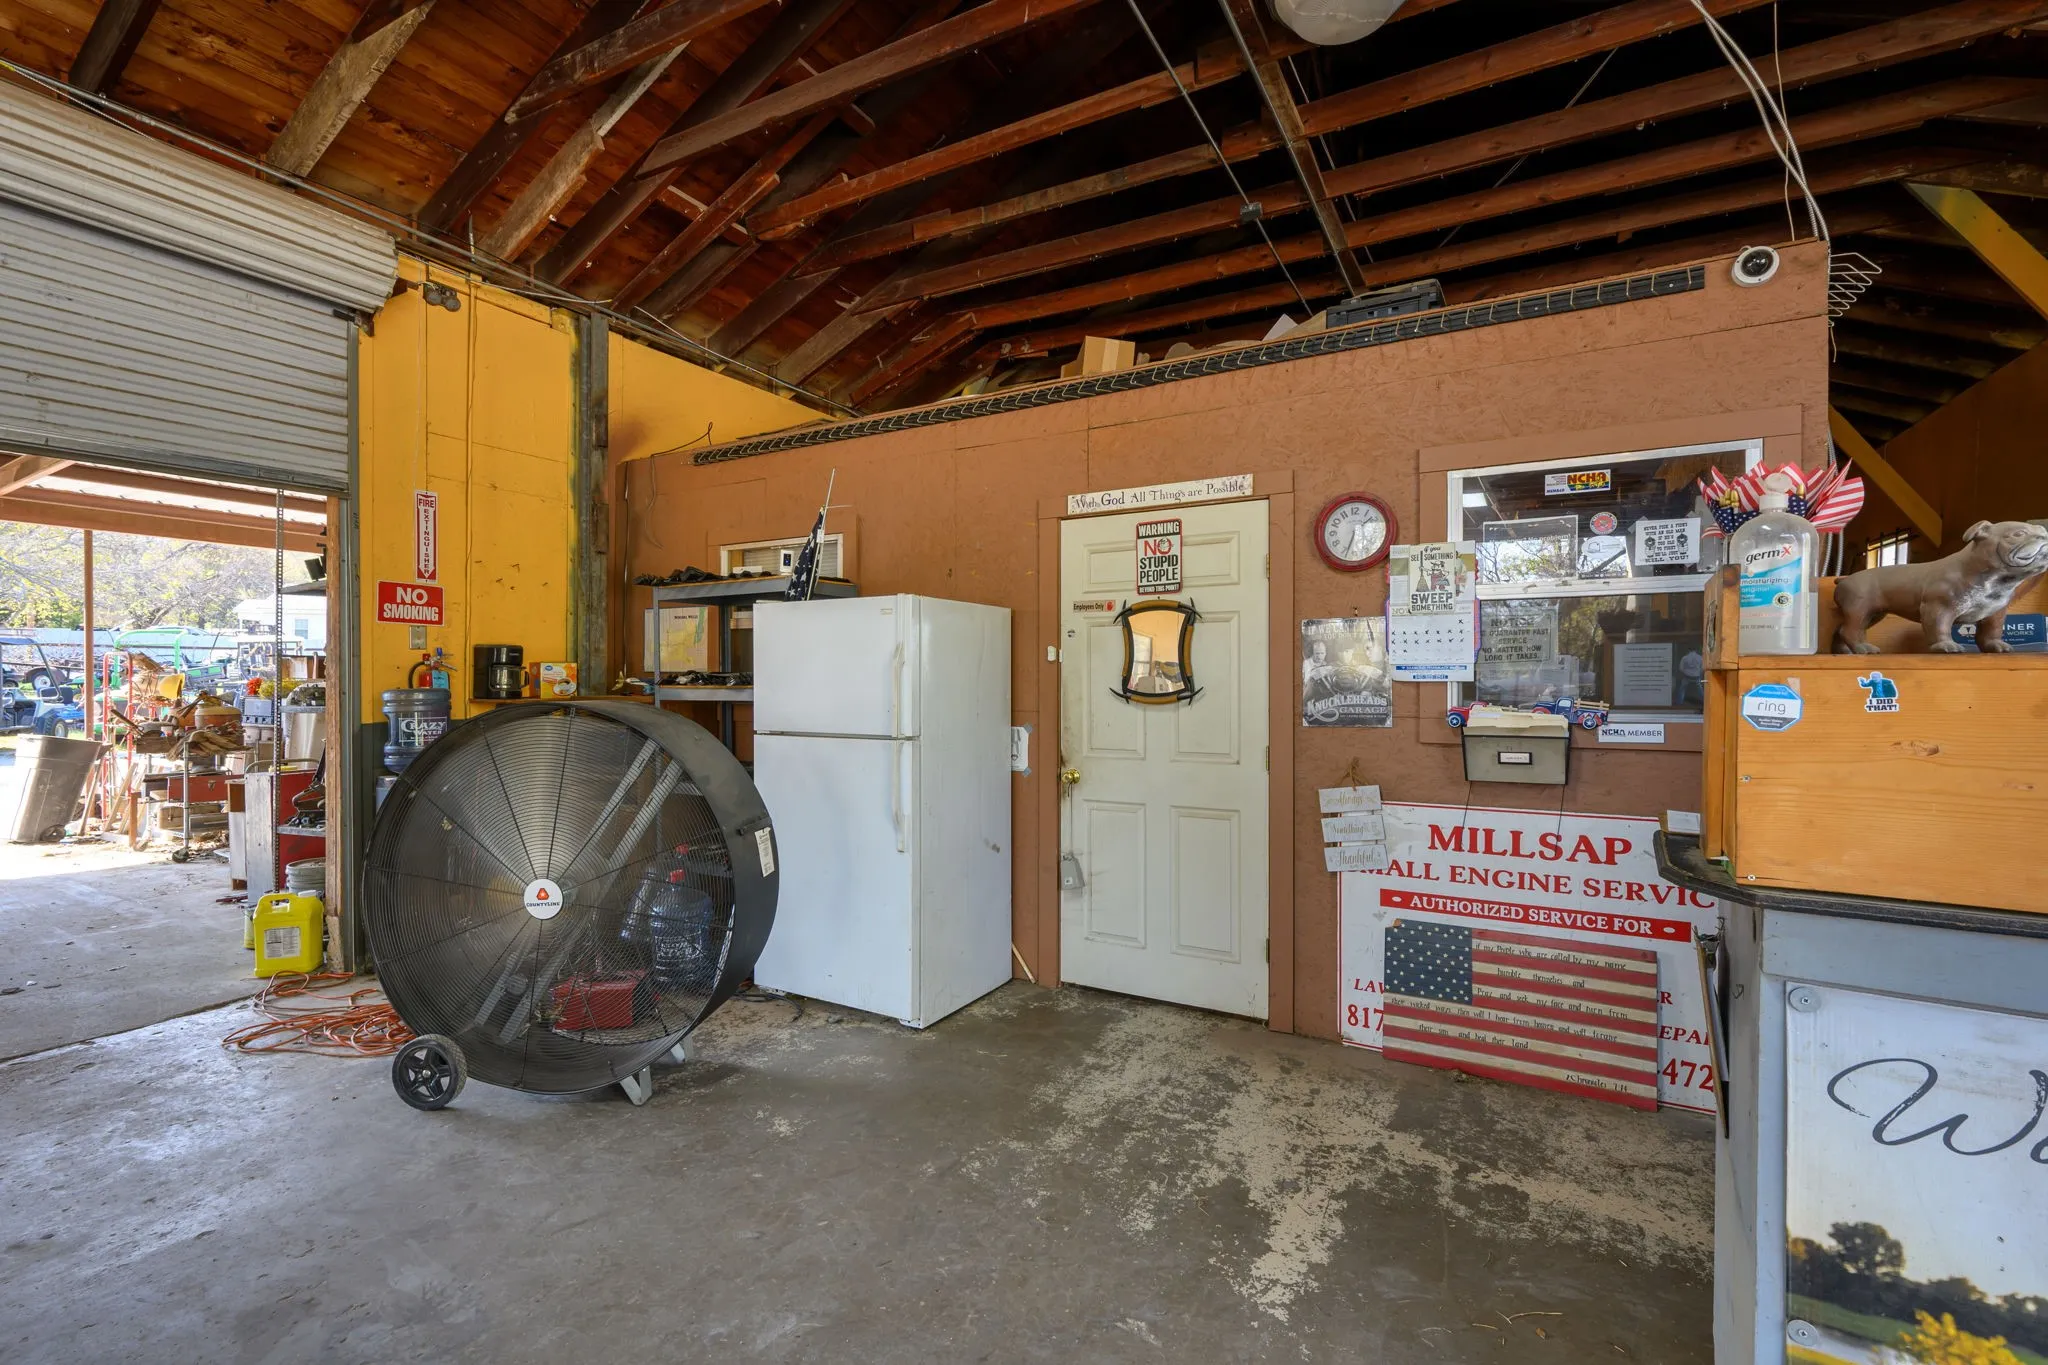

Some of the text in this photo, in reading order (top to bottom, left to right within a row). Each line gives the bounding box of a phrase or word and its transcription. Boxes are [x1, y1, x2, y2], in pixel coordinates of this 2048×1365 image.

[1075, 481, 1244, 509] With God All Things are Possible
[418, 498, 435, 508] FIRE
[1350, 506, 1360, 515] 12
[1138, 521, 1180, 537] WARNING
[1330, 518, 1341, 528] 10
[1144, 537, 1173, 556] NO
[1139, 554, 1179, 569] STUPID
[1424, 552, 1454, 561] SOMETHING
[1139, 567, 1179, 583] PEOPLE
[1741, 576, 1790, 585] moisturizing
[396, 587, 428, 605] NO
[1411, 592, 1453, 604] SWEEP
[383, 603, 439, 621] SMOKING
[1073, 602, 1105, 611] Employees Only
[1411, 603, 1453, 612] SOMETHING
[1532, 627, 1549, 635] FAST
[1526, 644, 1542, 652] HOW
[1506, 653, 1512, 661] IT
[1307, 694, 1388, 717] KNUCKLEHEADS
[1340, 705, 1388, 714] GARAGE
[1757, 700, 1787, 715] ring
[401, 718, 446, 733] CRAZY
[1602, 728, 1626, 737] NCHA
[1428, 823, 1633, 866] MILLSAP
[1449, 865, 1573, 895] ENGINE
[1583, 877, 1715, 909] SERVIC
[1410, 895, 1653, 935] AUTHORIZED SERVICE FOR
[1551, 953, 1571, 963] called
[1572, 980, 1586, 988] and
[1500, 992, 1512, 1001] and
[1568, 1003, 1582, 1013] and
[1458, 1030, 1471, 1040] and
[1511, 1038, 1530, 1049] land
